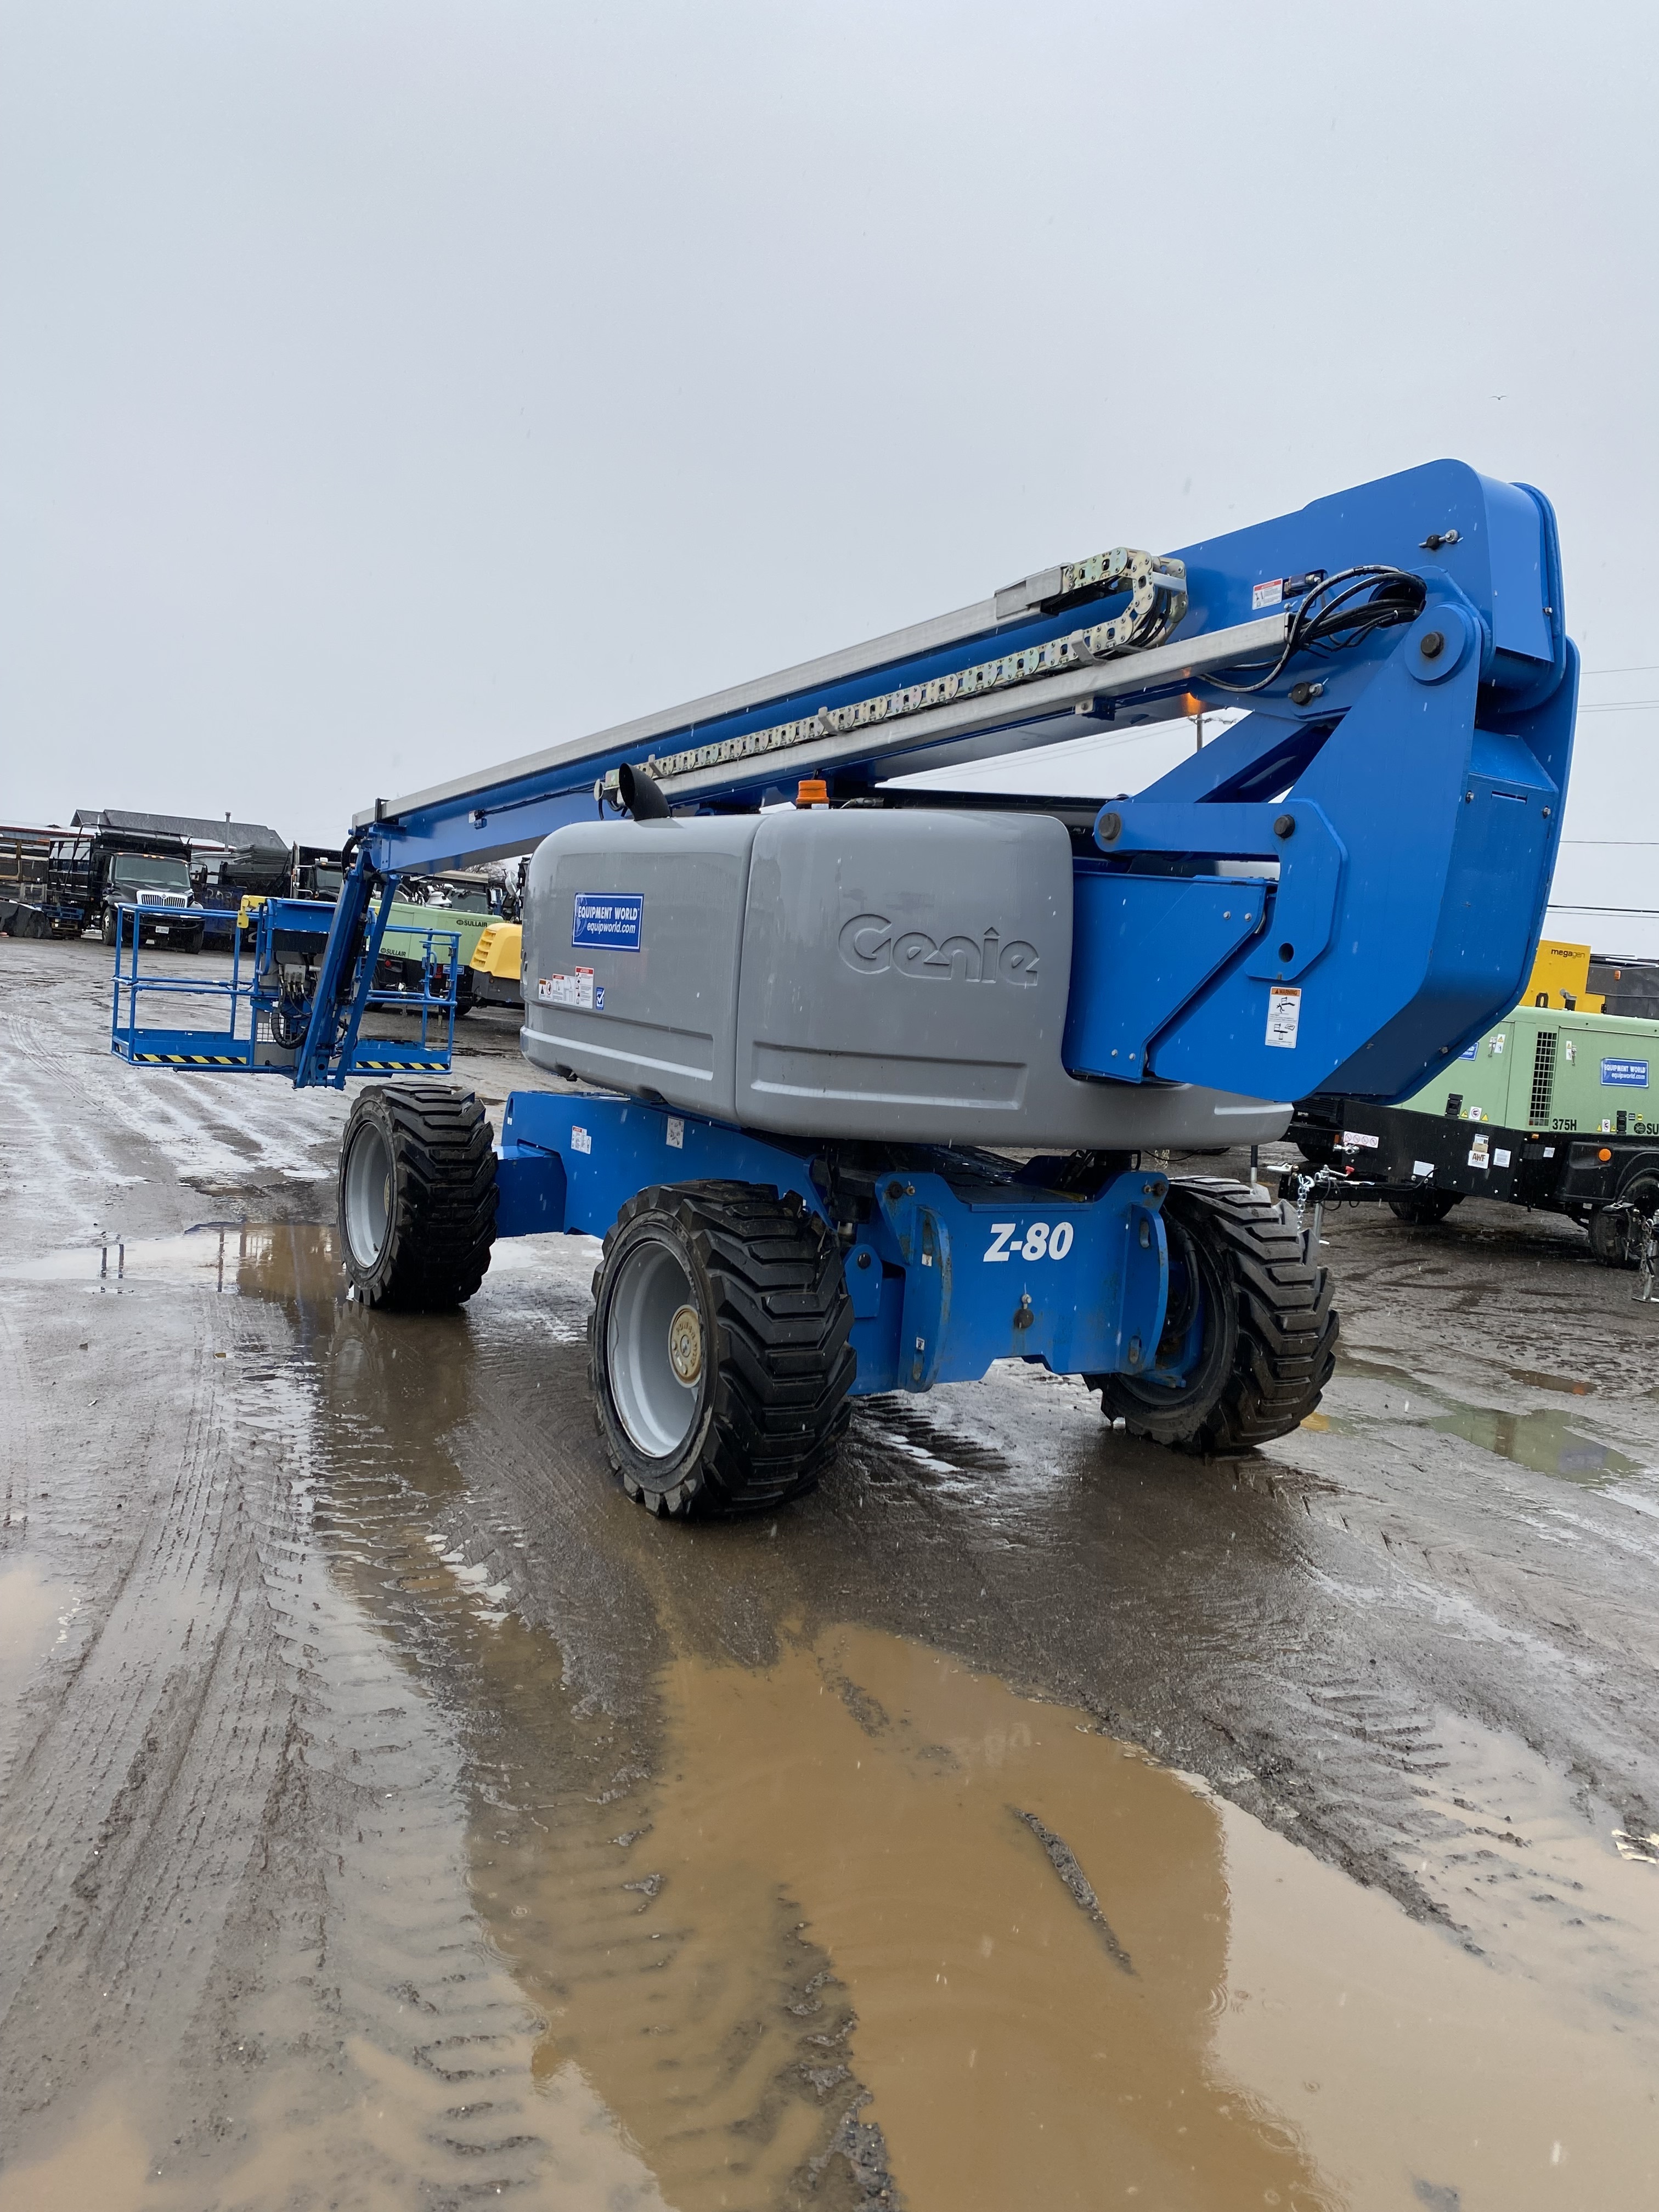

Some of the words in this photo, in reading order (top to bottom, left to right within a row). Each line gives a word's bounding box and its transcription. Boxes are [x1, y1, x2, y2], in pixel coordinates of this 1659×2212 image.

[578, 906, 612, 919] EQUIPMENT
[614, 907, 637, 921] WORLD
[586, 920, 636, 934] equipworld.com
[386, 949, 406, 957] SULLAIR
[838, 913, 1040, 986] Genie
[1550, 949, 1585, 958] megagen
[1552, 1118, 1577, 1131] 375H
[983, 1222, 1074, 1262] Z-80
